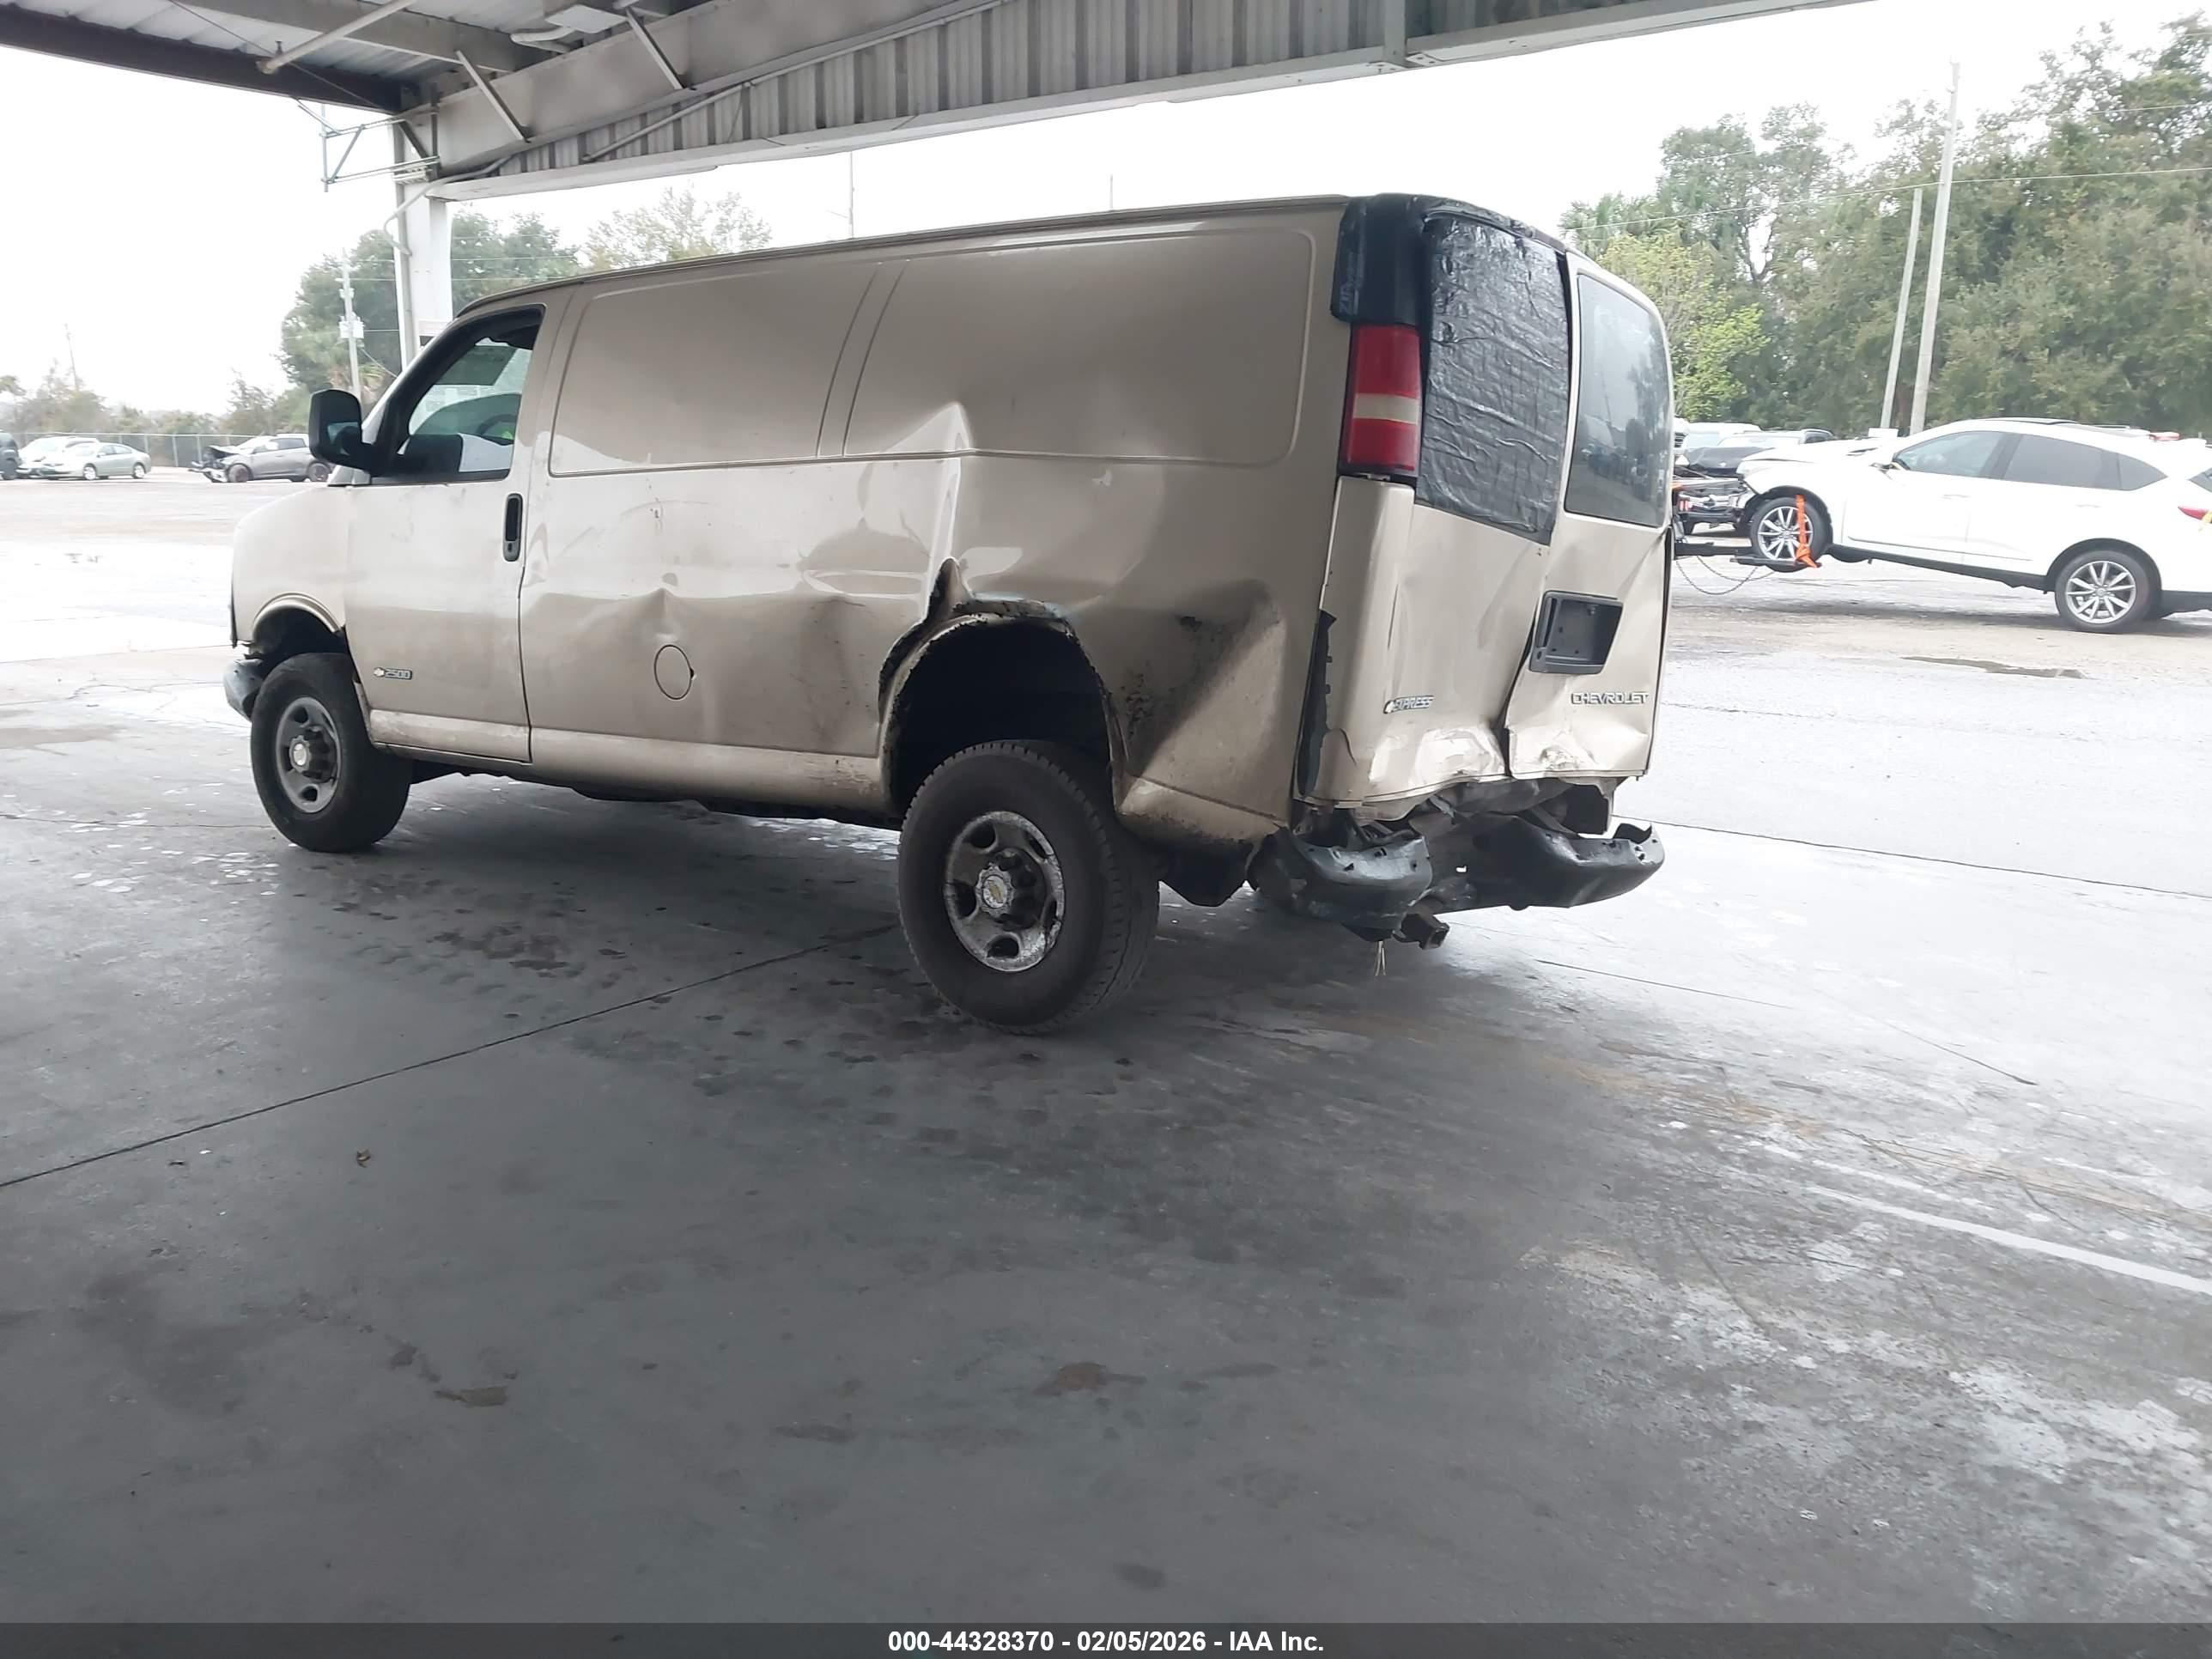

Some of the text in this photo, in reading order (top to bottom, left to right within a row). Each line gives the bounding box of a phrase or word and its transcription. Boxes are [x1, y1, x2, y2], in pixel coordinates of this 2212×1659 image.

[384, 669, 411, 680] 2500
[1394, 695, 1435, 711] EXPRESS
[1571, 692, 1650, 705] CHEVROLET
